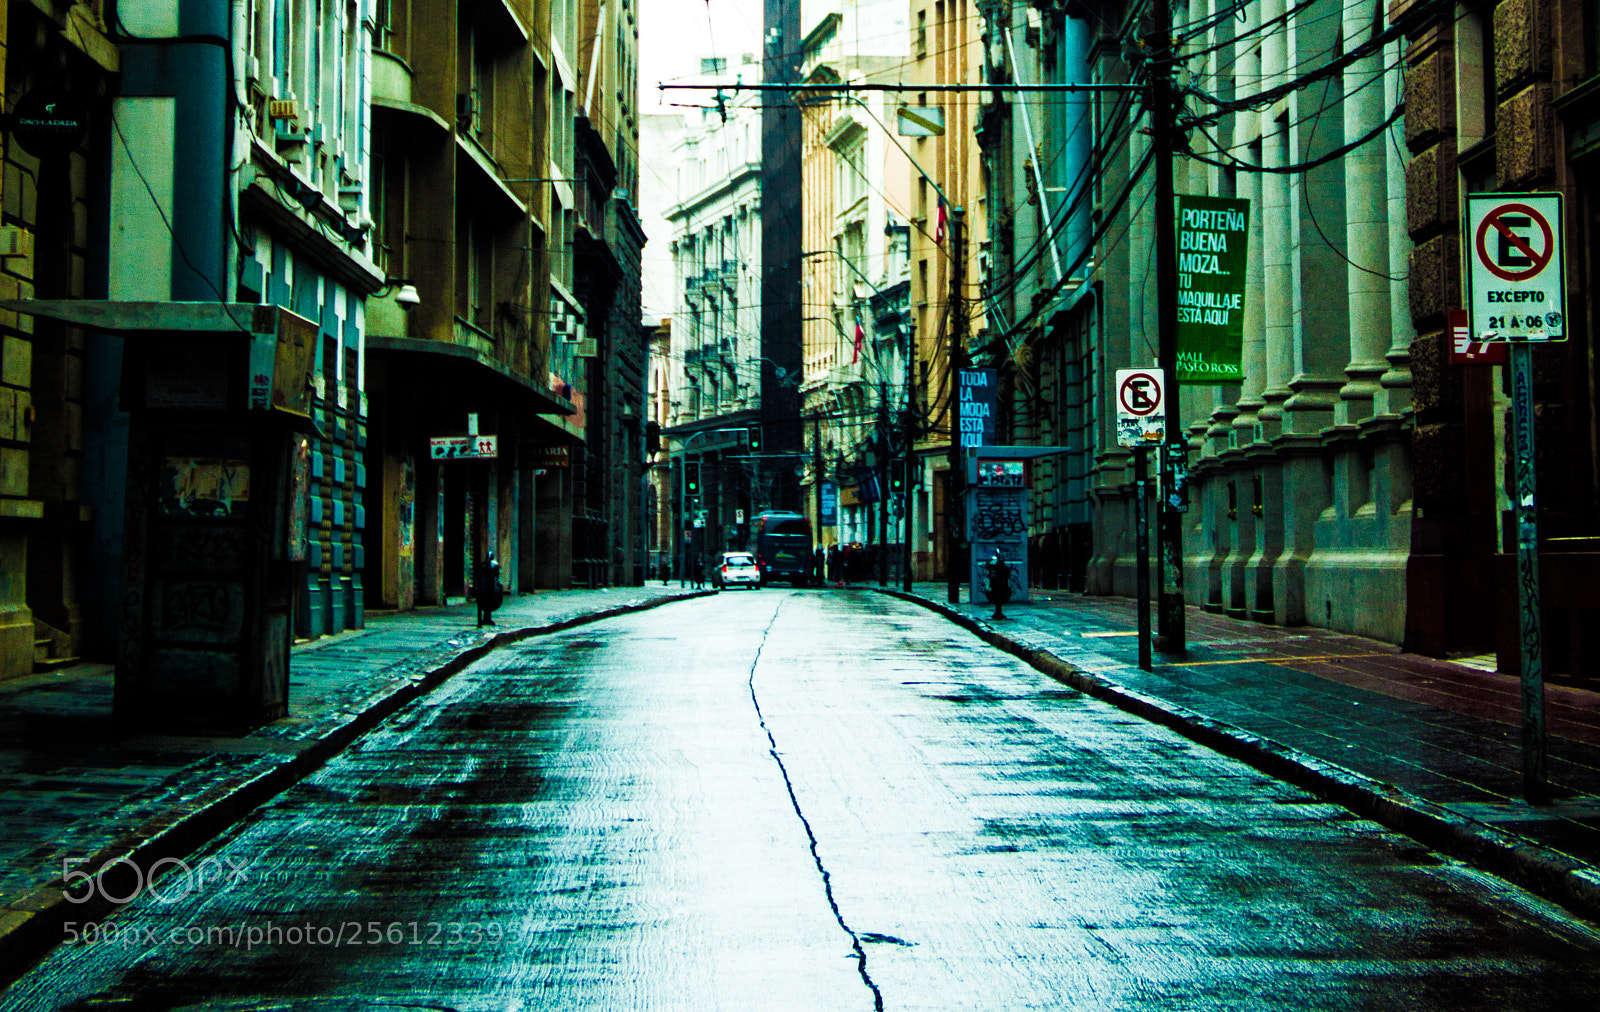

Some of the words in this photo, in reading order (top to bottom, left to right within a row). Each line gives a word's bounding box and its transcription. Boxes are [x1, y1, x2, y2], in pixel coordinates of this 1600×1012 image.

[1181, 208, 1245, 232] PORTEÑA
[1180, 231, 1227, 252] BUENA
[1179, 253, 1230, 275] MOZA...
[1178, 273, 1192, 288] TU
[1178, 290, 1242, 309] MAQUILLAJE
[1488, 291, 1545, 303] EXCEPTO
[1489, 316, 1505, 328] 21
[1526, 315, 1543, 328] 06
[1176, 352, 1204, 363] MALL
[1176, 362, 1209, 372] PASEO
[1211, 363, 1238, 373] ROSS
[960, 371, 988, 386] TODA
[960, 386, 973, 401] LA
[960, 402, 990, 418] MODA
